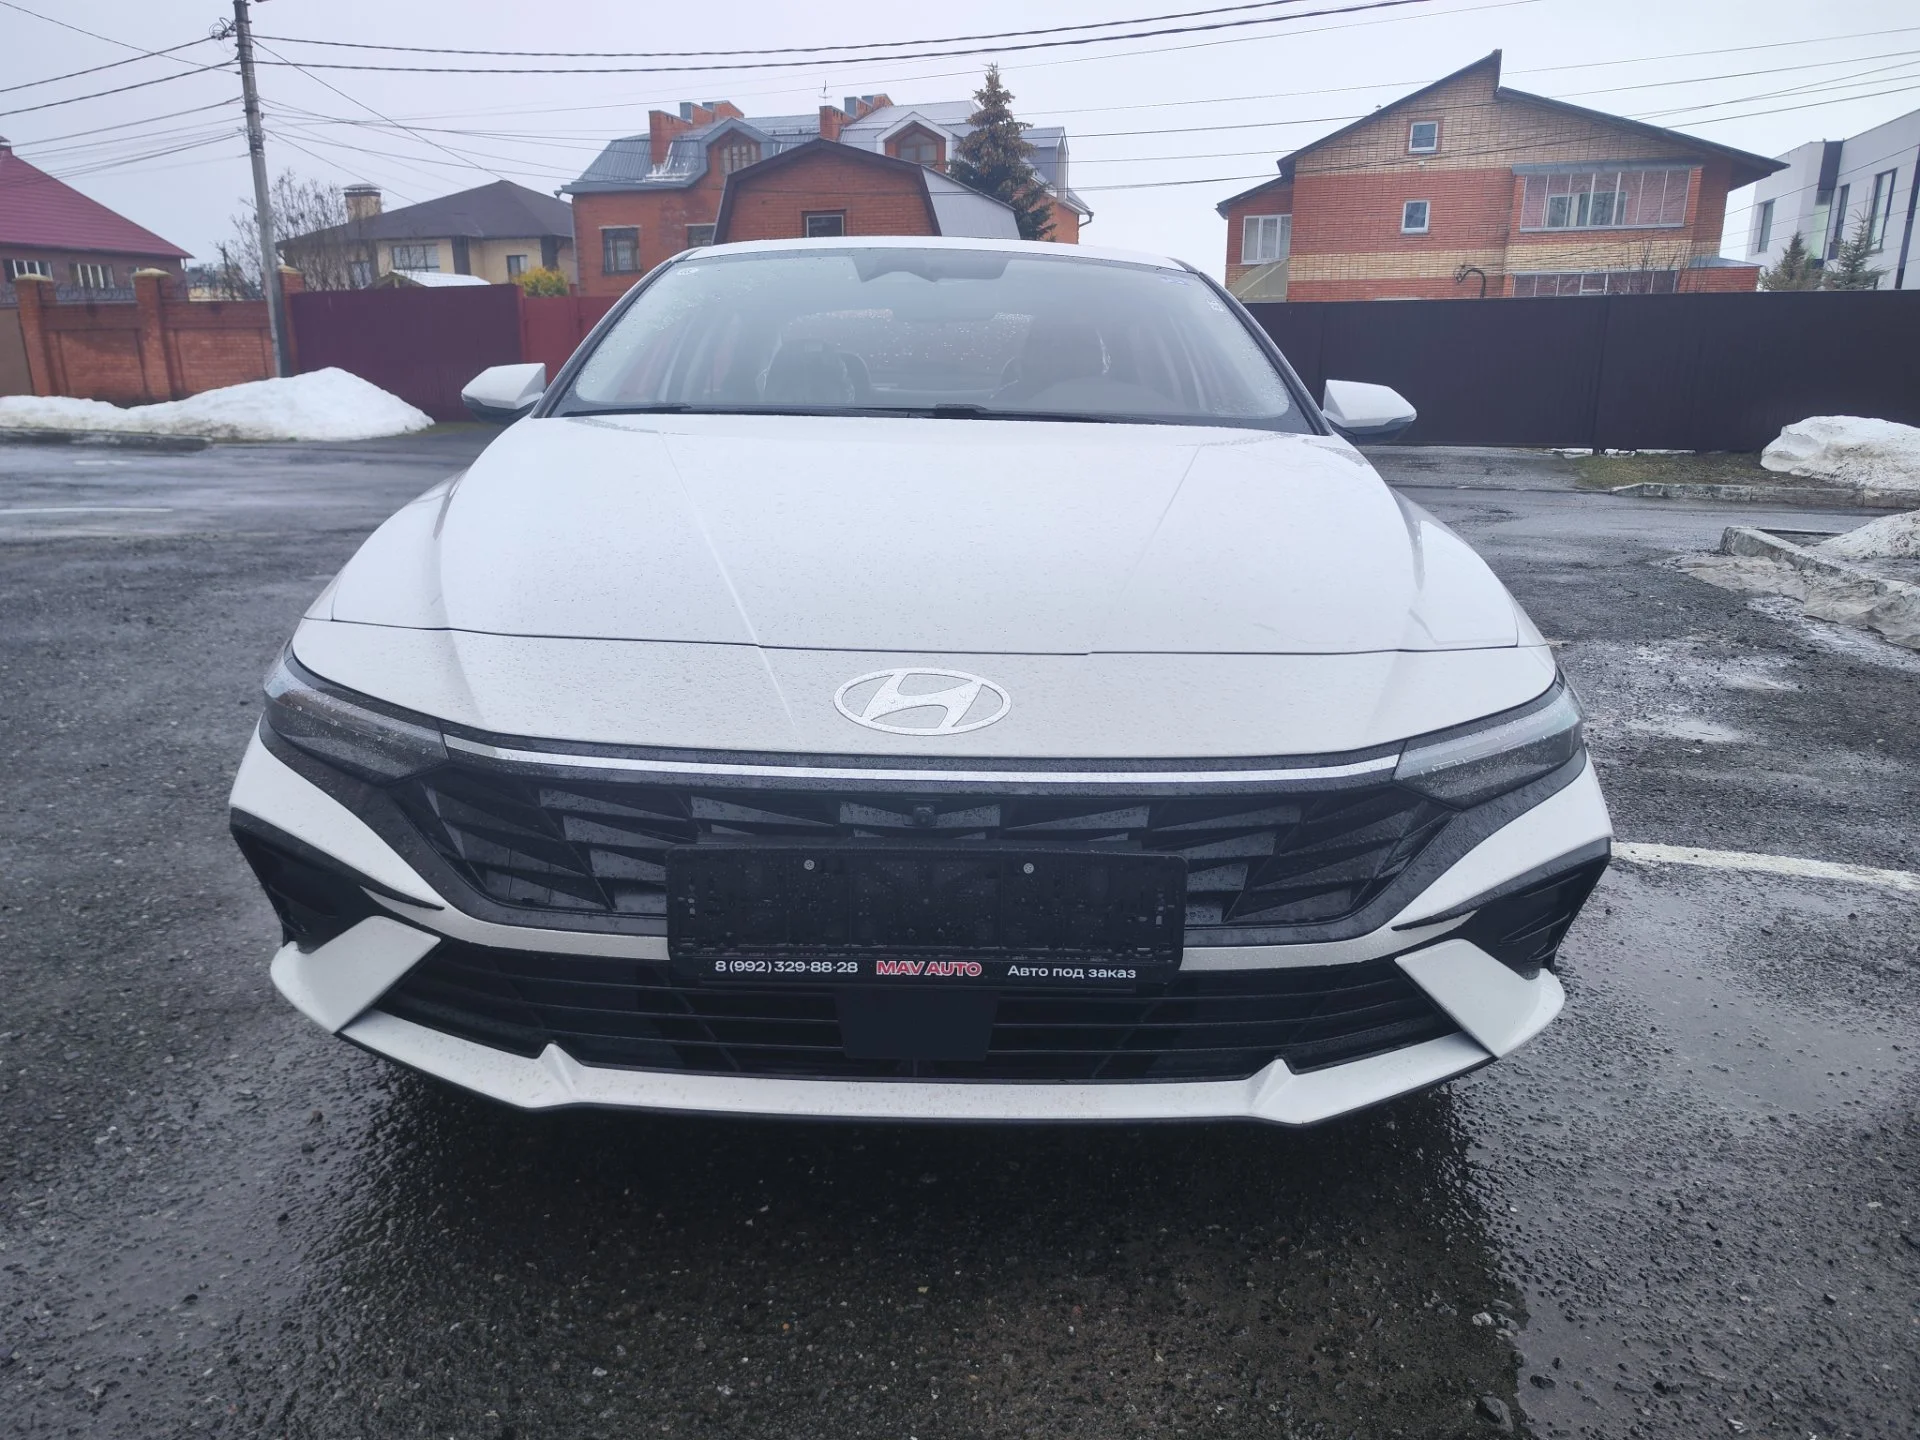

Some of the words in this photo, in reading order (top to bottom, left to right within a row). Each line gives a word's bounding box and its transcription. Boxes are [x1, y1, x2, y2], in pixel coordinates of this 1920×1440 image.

[774, 961, 858, 973] 329-88-28
[1007, 964, 1049, 977] Авто
[1052, 968, 1085, 980] под
[1087, 968, 1137, 979] заказ
